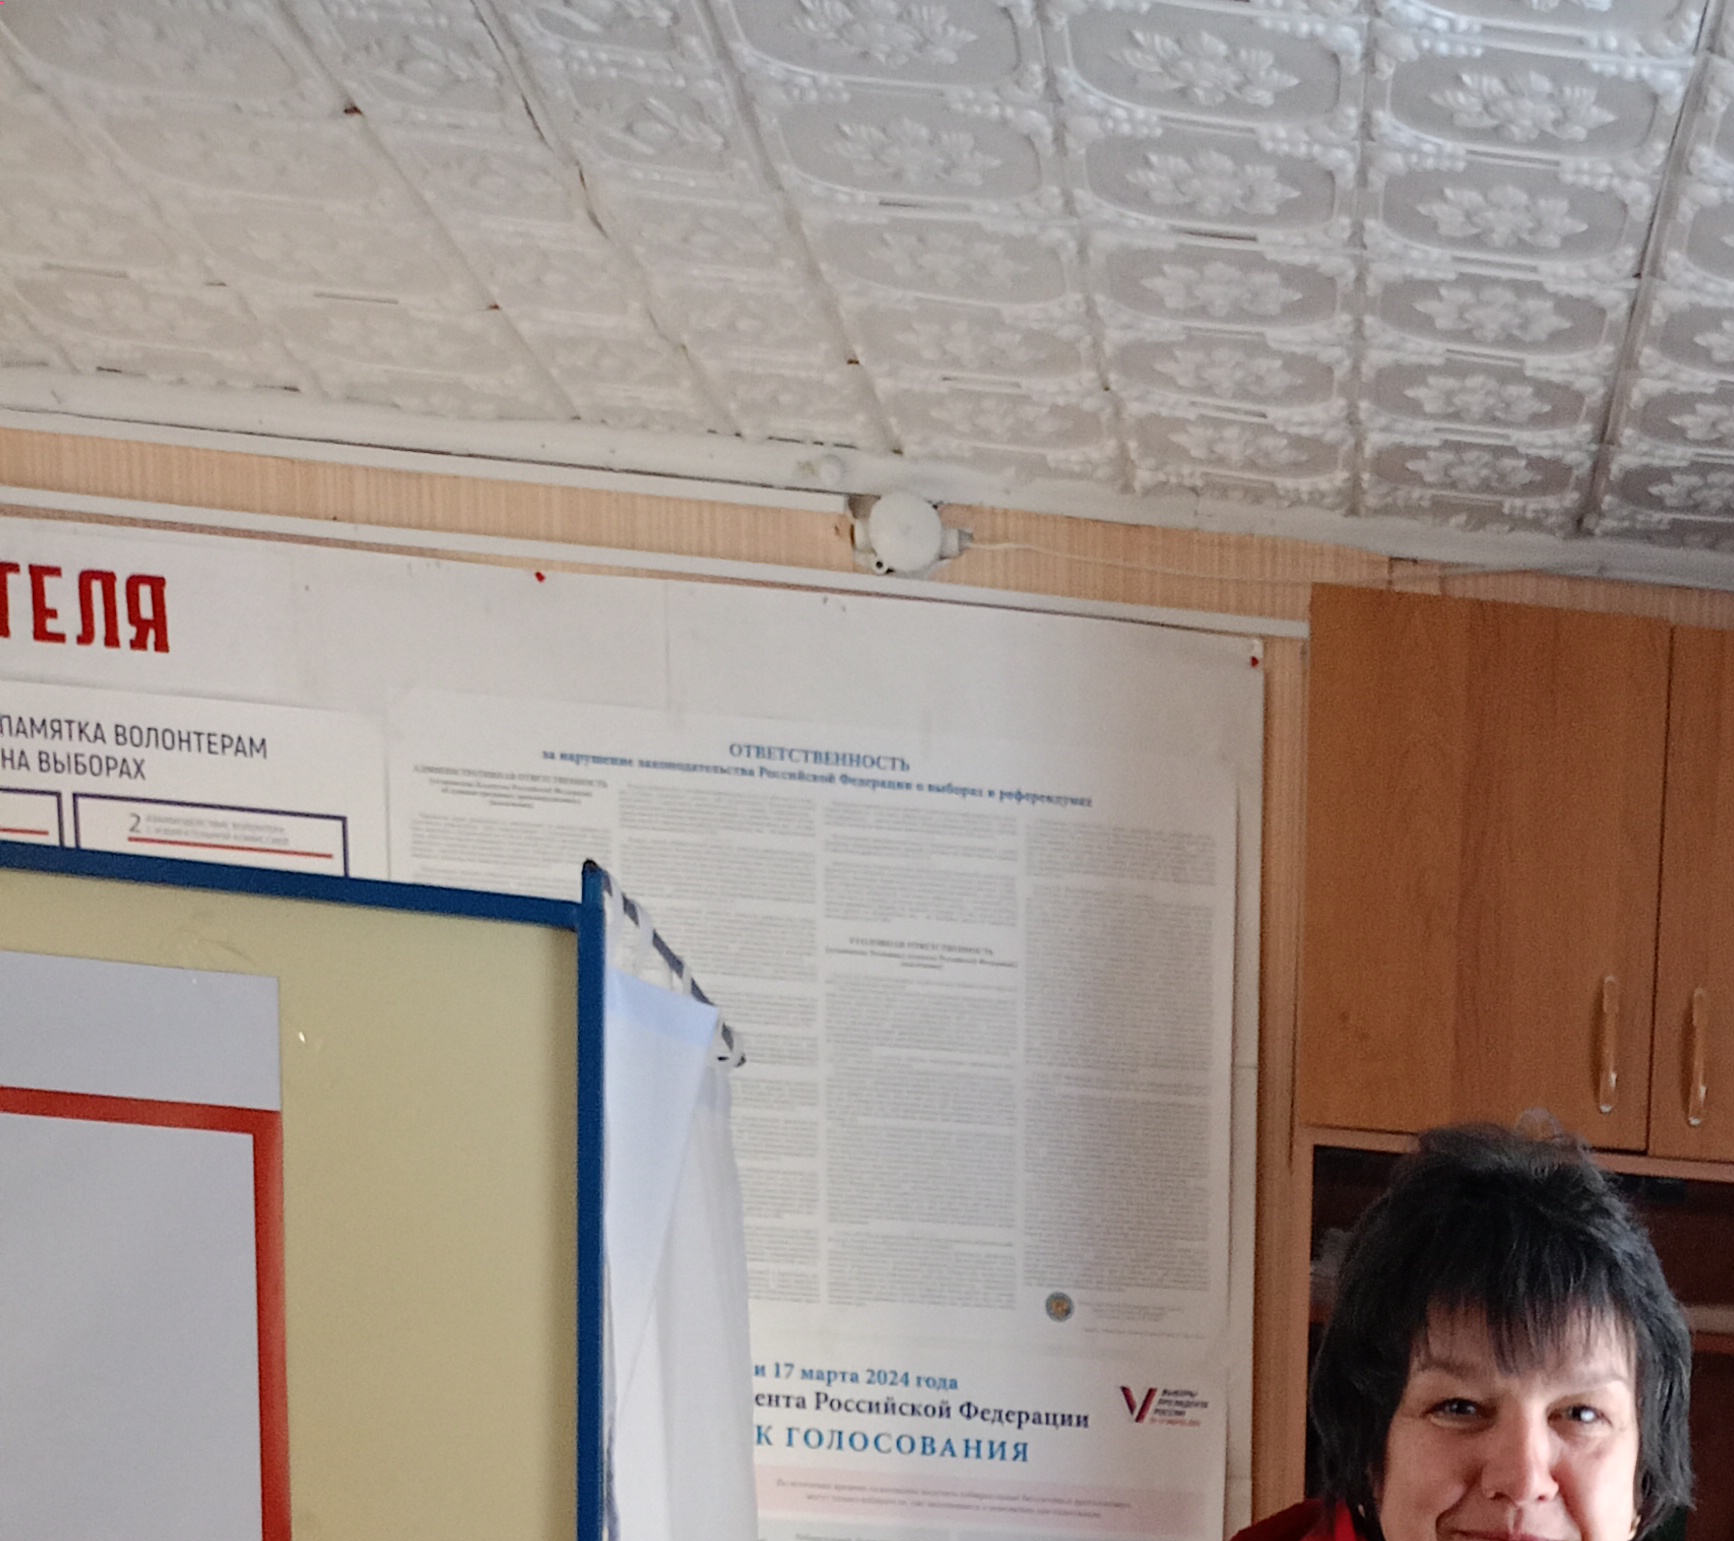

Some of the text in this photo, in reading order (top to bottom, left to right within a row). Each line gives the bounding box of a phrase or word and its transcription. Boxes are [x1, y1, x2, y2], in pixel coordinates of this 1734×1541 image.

[0, 714, 268, 759] ПАМЯТКА ВОЛОНТЕРАМ
[0, 748, 147, 781] НА ВЫБОРАХ
[729, 743, 911, 773] ОТВЕТСТВЕННОСТЬ
[759, 765, 836, 784] Российской
[839, 772, 913, 793] Федерации
[129, 812, 142, 834] 2
[754, 1362, 959, 1391] и 17 марта 2024 года
[754, 1391, 1090, 1429] ента Российской Федерации
[754, 1424, 1030, 1463] К ГОЛОСОВАНИЯ
